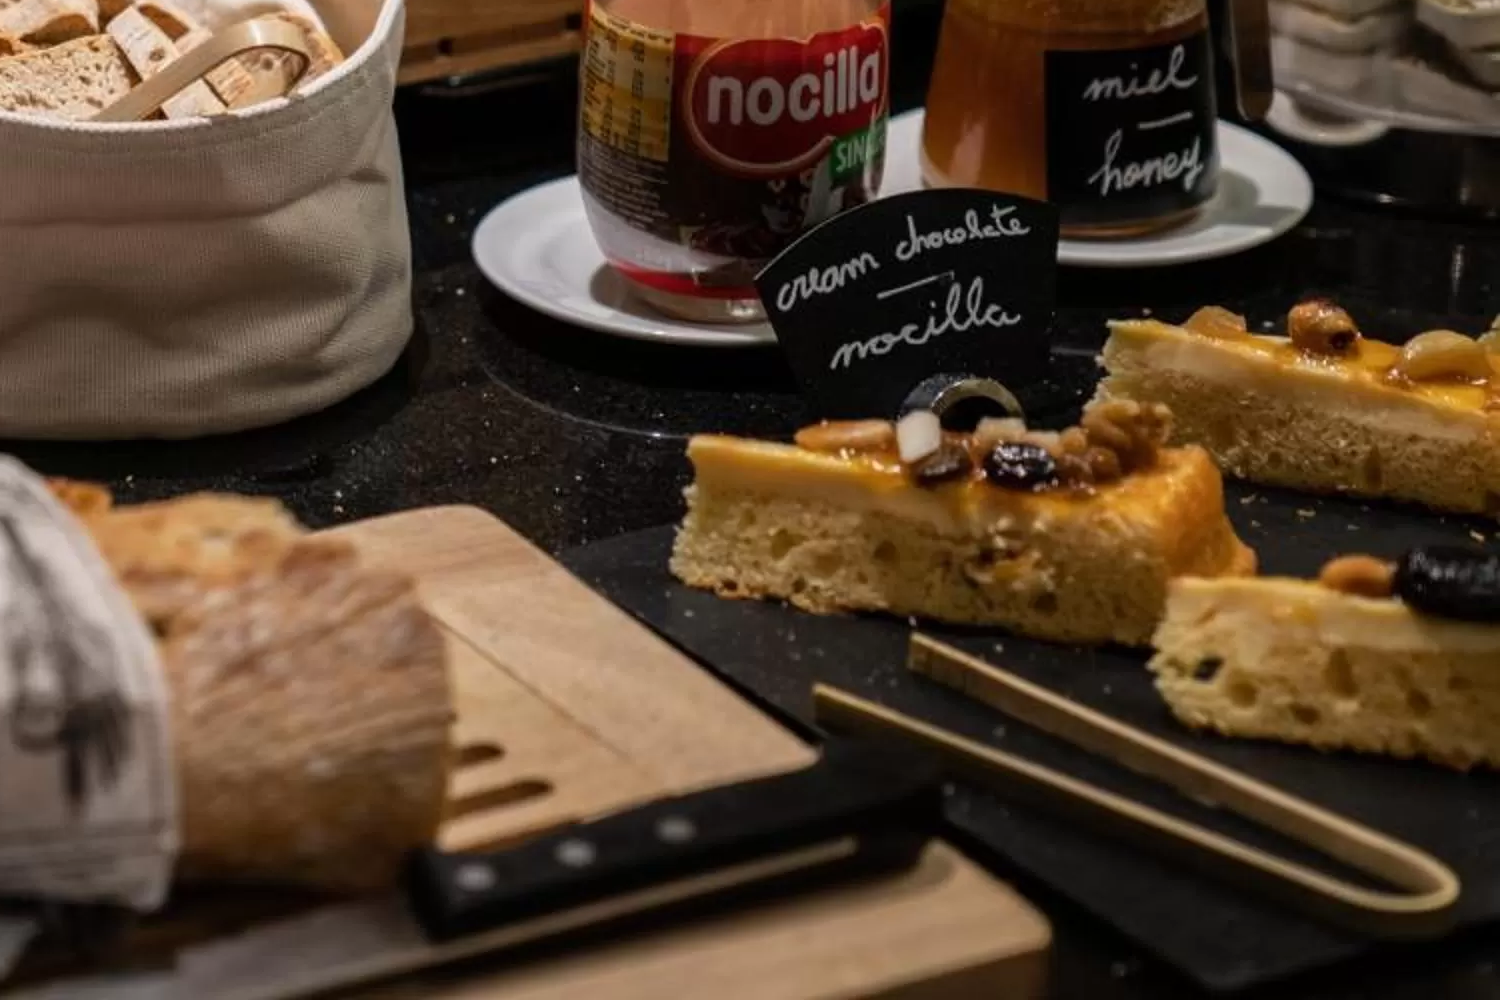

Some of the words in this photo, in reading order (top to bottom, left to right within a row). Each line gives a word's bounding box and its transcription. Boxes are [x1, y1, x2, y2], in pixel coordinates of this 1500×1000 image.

[707, 45, 881, 127] nocilla
[1082, 44, 1199, 101] miel
[1087, 128, 1205, 197] honey
[776, 251, 881, 312] cream
[895, 203, 1032, 261] chocolate
[829, 276, 1021, 370] nocilla
